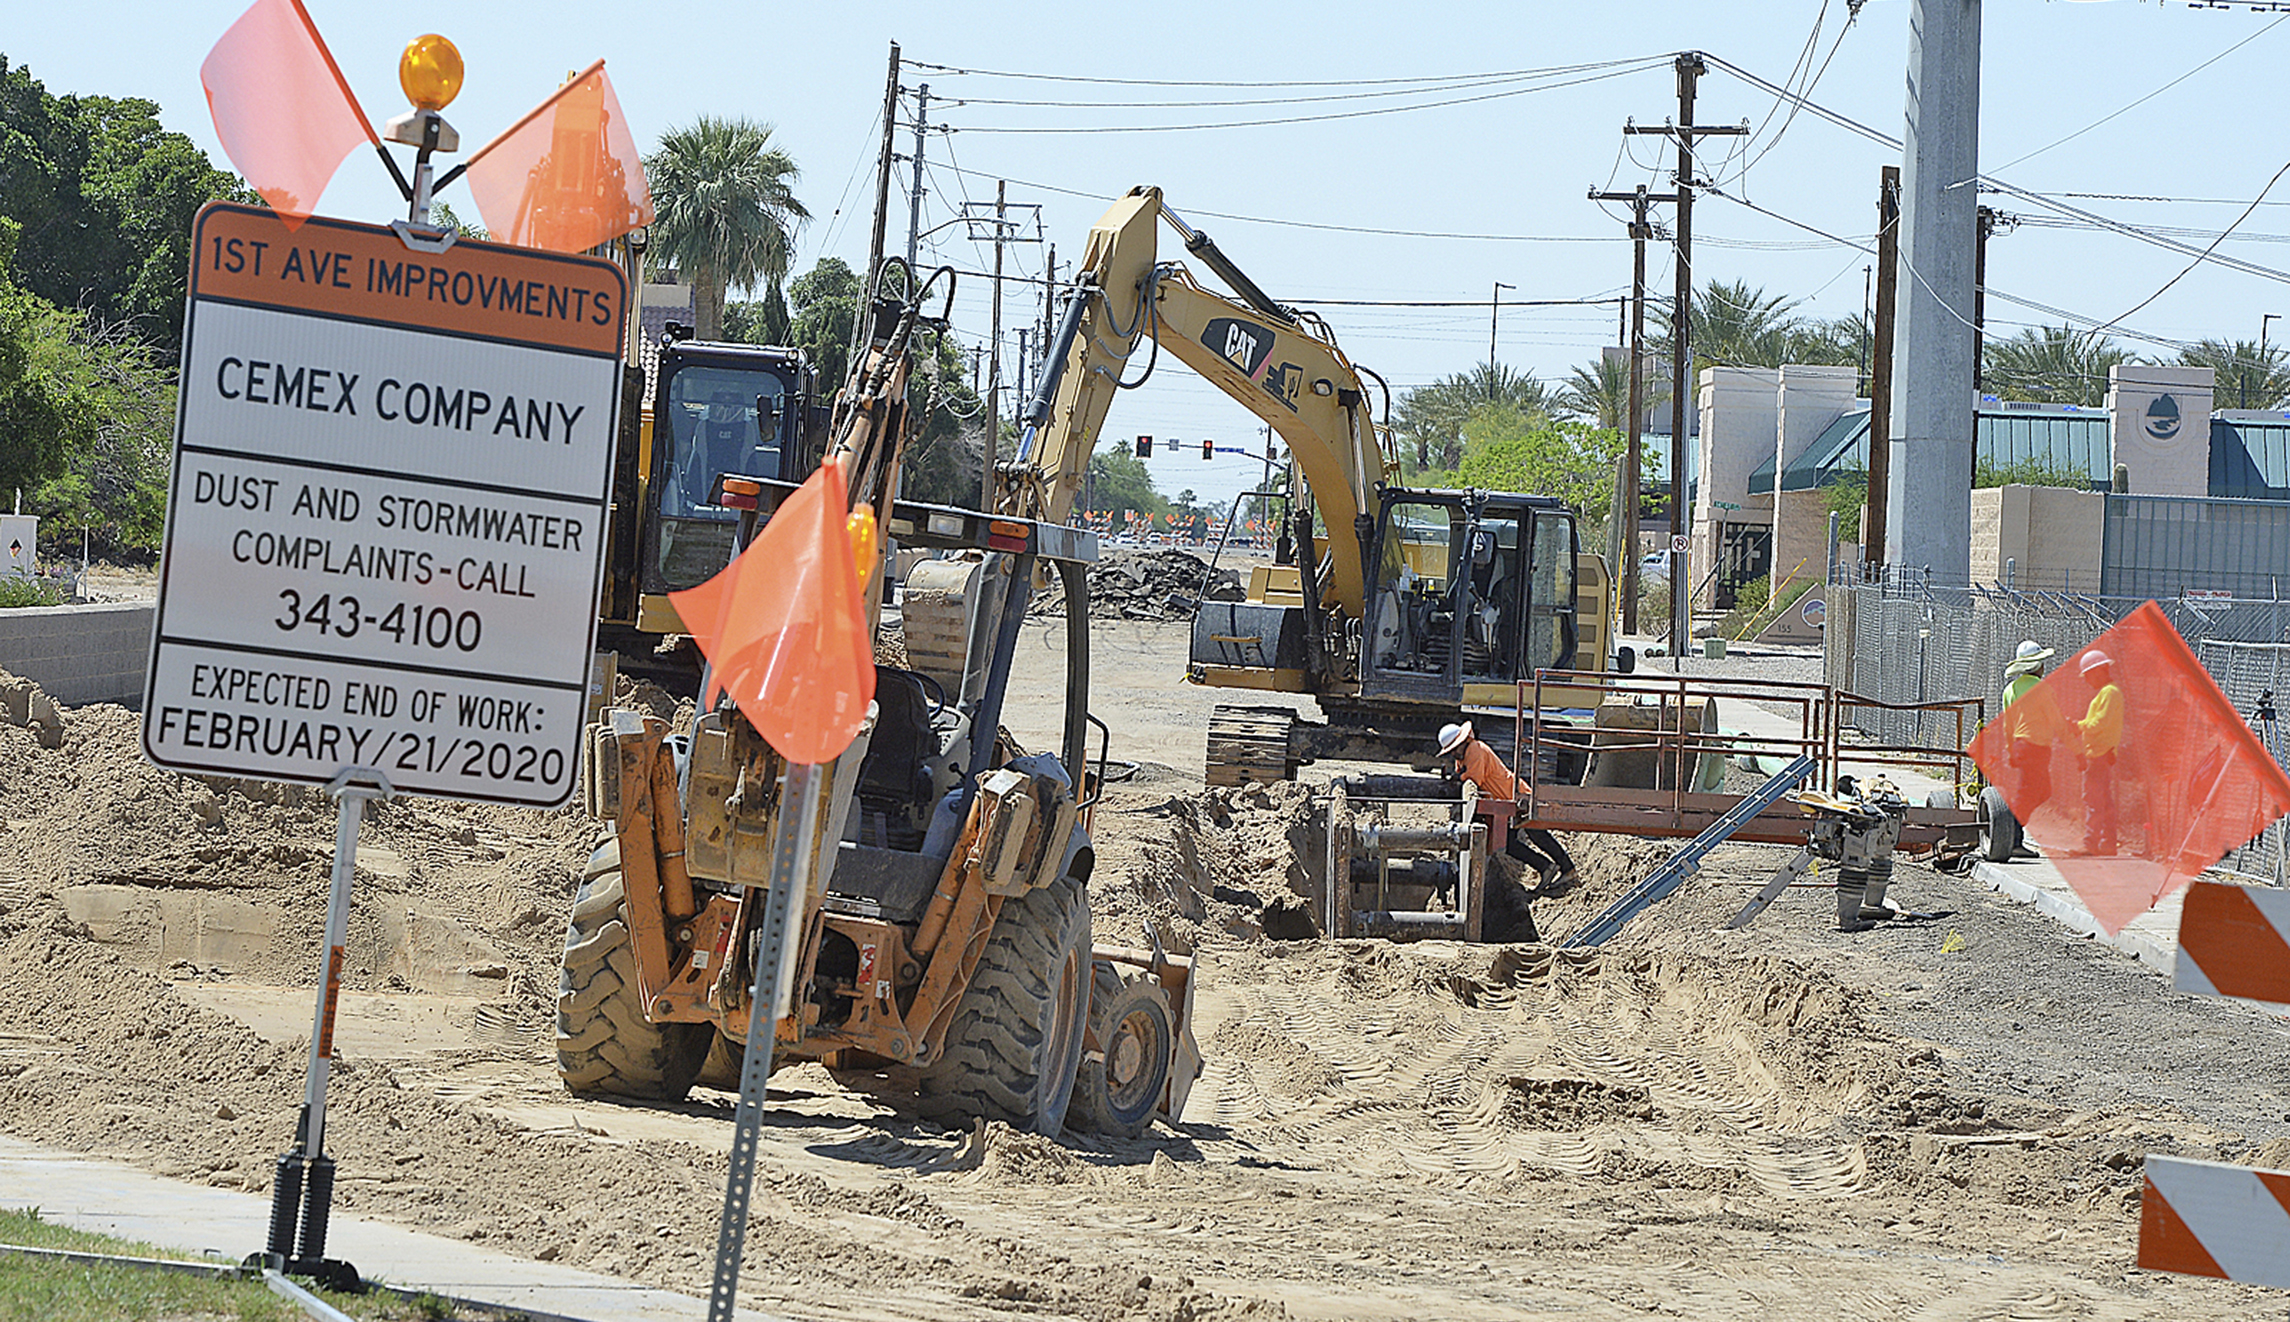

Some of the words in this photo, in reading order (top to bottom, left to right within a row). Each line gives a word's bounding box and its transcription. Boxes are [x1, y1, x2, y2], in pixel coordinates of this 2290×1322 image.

[213, 236, 268, 276] 1ST
[281, 247, 353, 289] AVE
[367, 258, 612, 326] IMPROVMENTS
[1223, 322, 1258, 373] CAT
[218, 357, 359, 415] CEMEX
[376, 379, 584, 444] COMPANY
[195, 471, 279, 512] DUST
[292, 485, 359, 522] AND
[377, 495, 582, 551] STORMWATER
[275, 589, 481, 652] 343-4100
[192, 664, 330, 710] EXPECTED
[344, 682, 397, 717] END
[411, 690, 446, 723] OF
[459, 695, 544, 734] WORK:
[157, 706, 564, 785] FEBRUARY/21/2020
